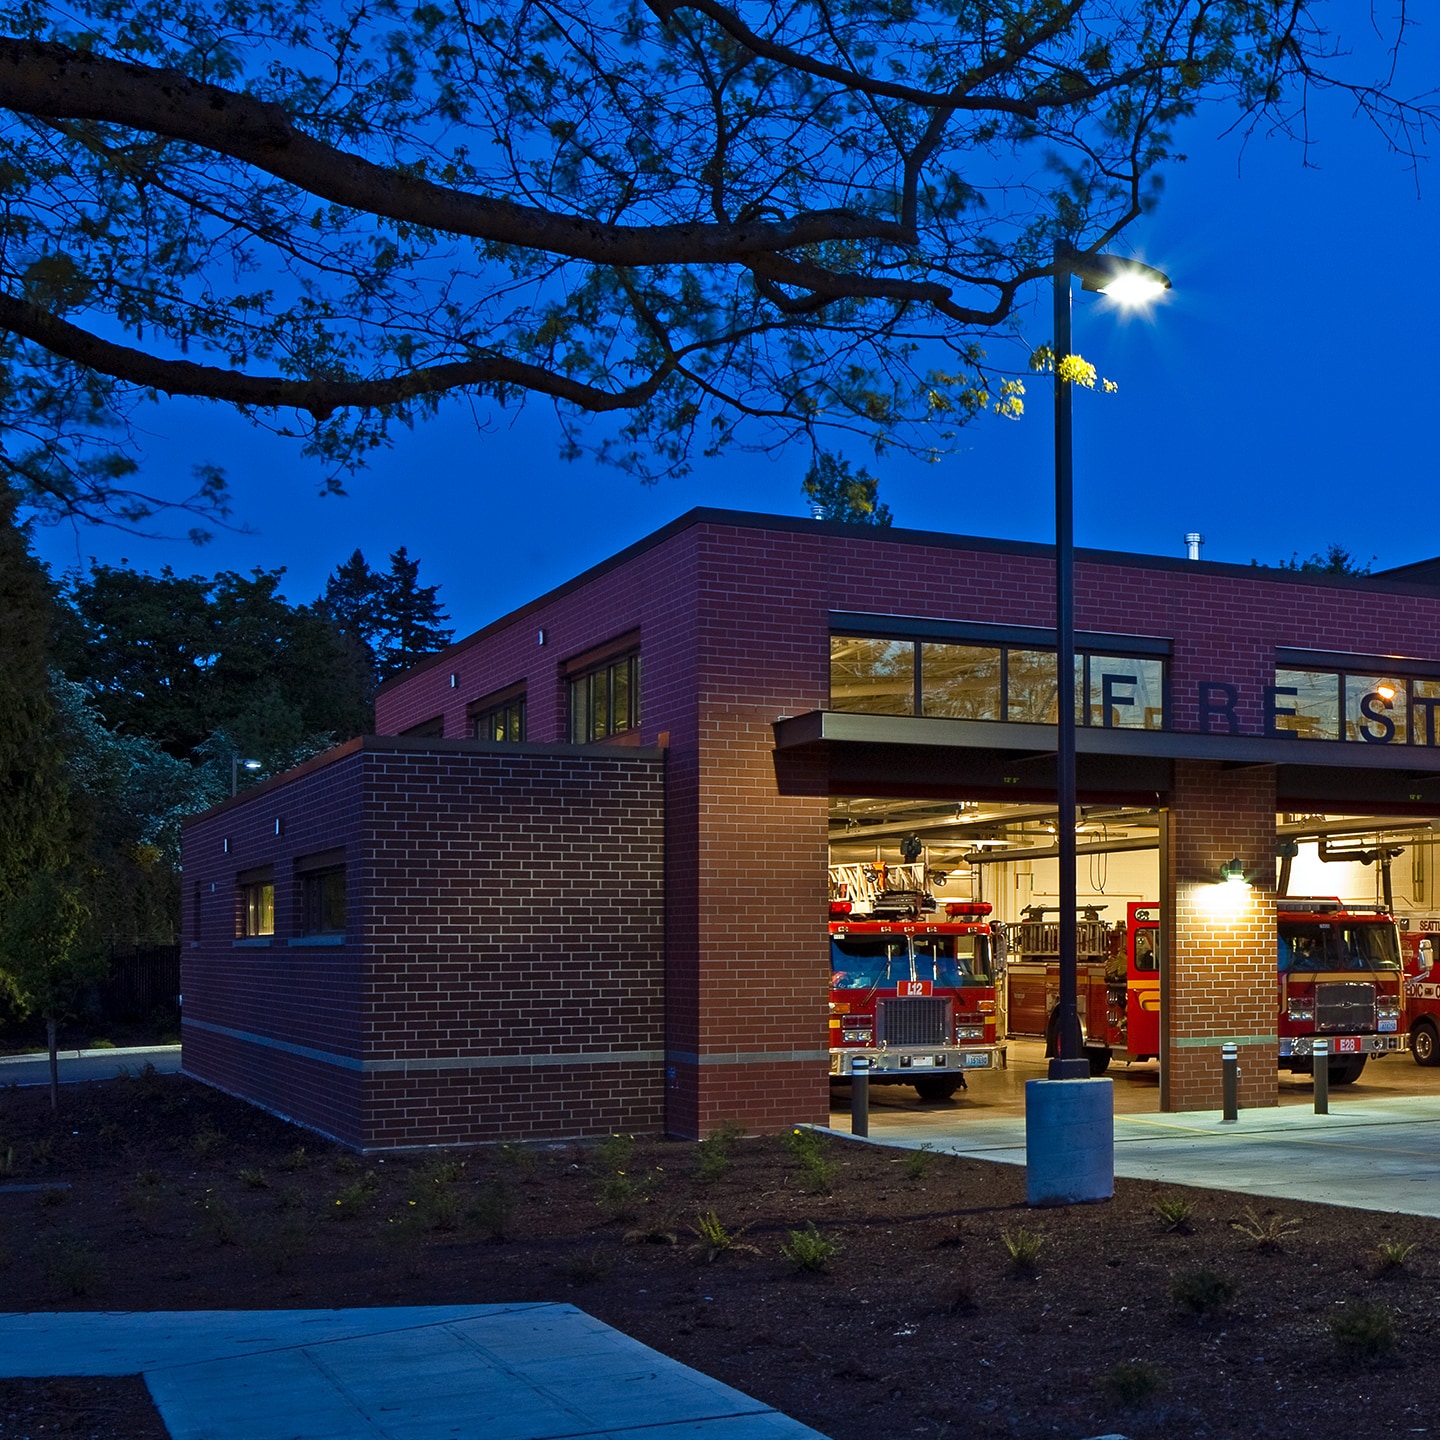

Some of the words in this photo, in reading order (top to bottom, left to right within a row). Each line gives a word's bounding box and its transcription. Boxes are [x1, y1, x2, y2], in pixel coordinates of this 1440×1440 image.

[1102, 673, 1298, 738] FIRE
[907, 983, 923, 996] L12
[1406, 983, 1423, 998] EDIC
[1340, 1039, 1355, 1051] E28
